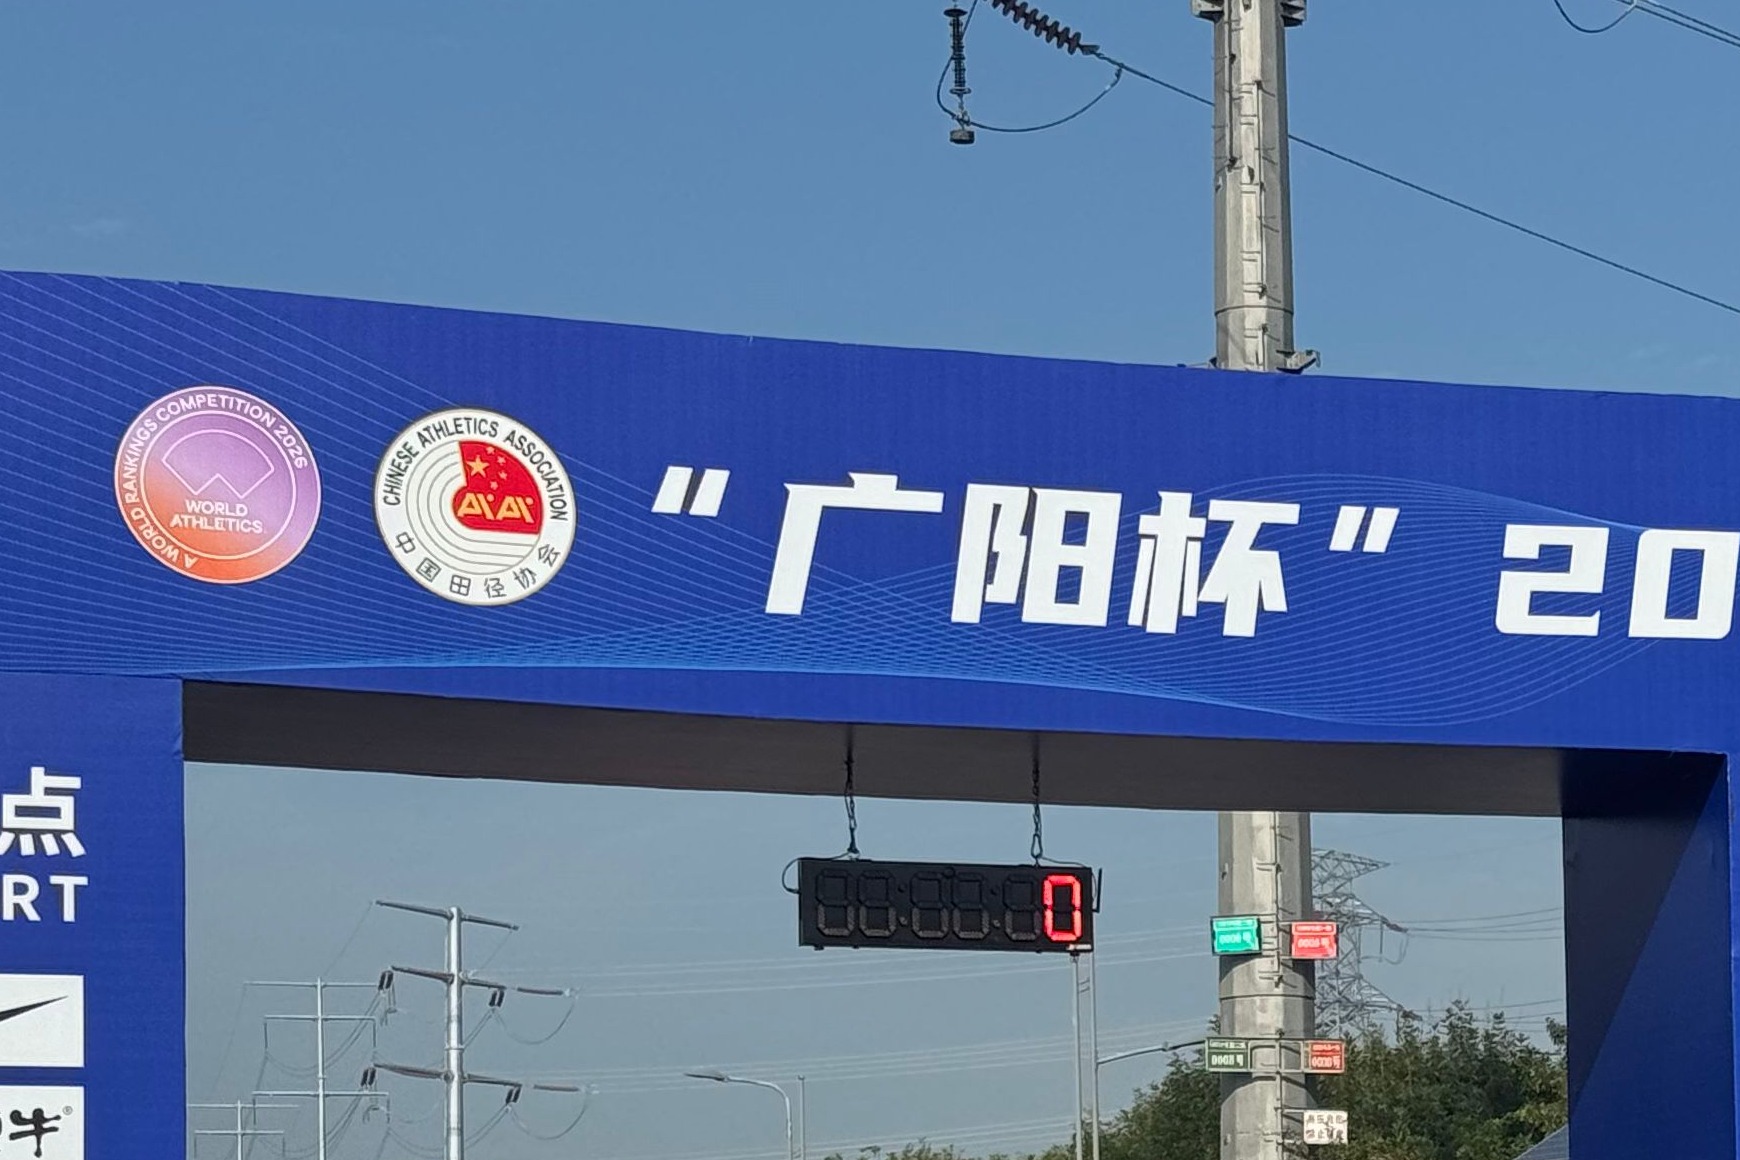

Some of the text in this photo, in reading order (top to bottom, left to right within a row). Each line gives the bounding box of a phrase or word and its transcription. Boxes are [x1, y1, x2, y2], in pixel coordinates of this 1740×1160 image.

[123, 393, 308, 569] A WORLD RANKINGS COMPETITION 2026
[383, 417, 569, 521] CHINESE ATHLETICS ASSOCIATION
[169, 514, 263, 534] ATHLETICS
[185, 499, 249, 518] WORLD
[395, 531, 561, 599] 中国田径协会
[0, 766, 87, 858] 点
[1042, 874, 1083, 943] 0
[0, 1107, 62, 1158] 牛
